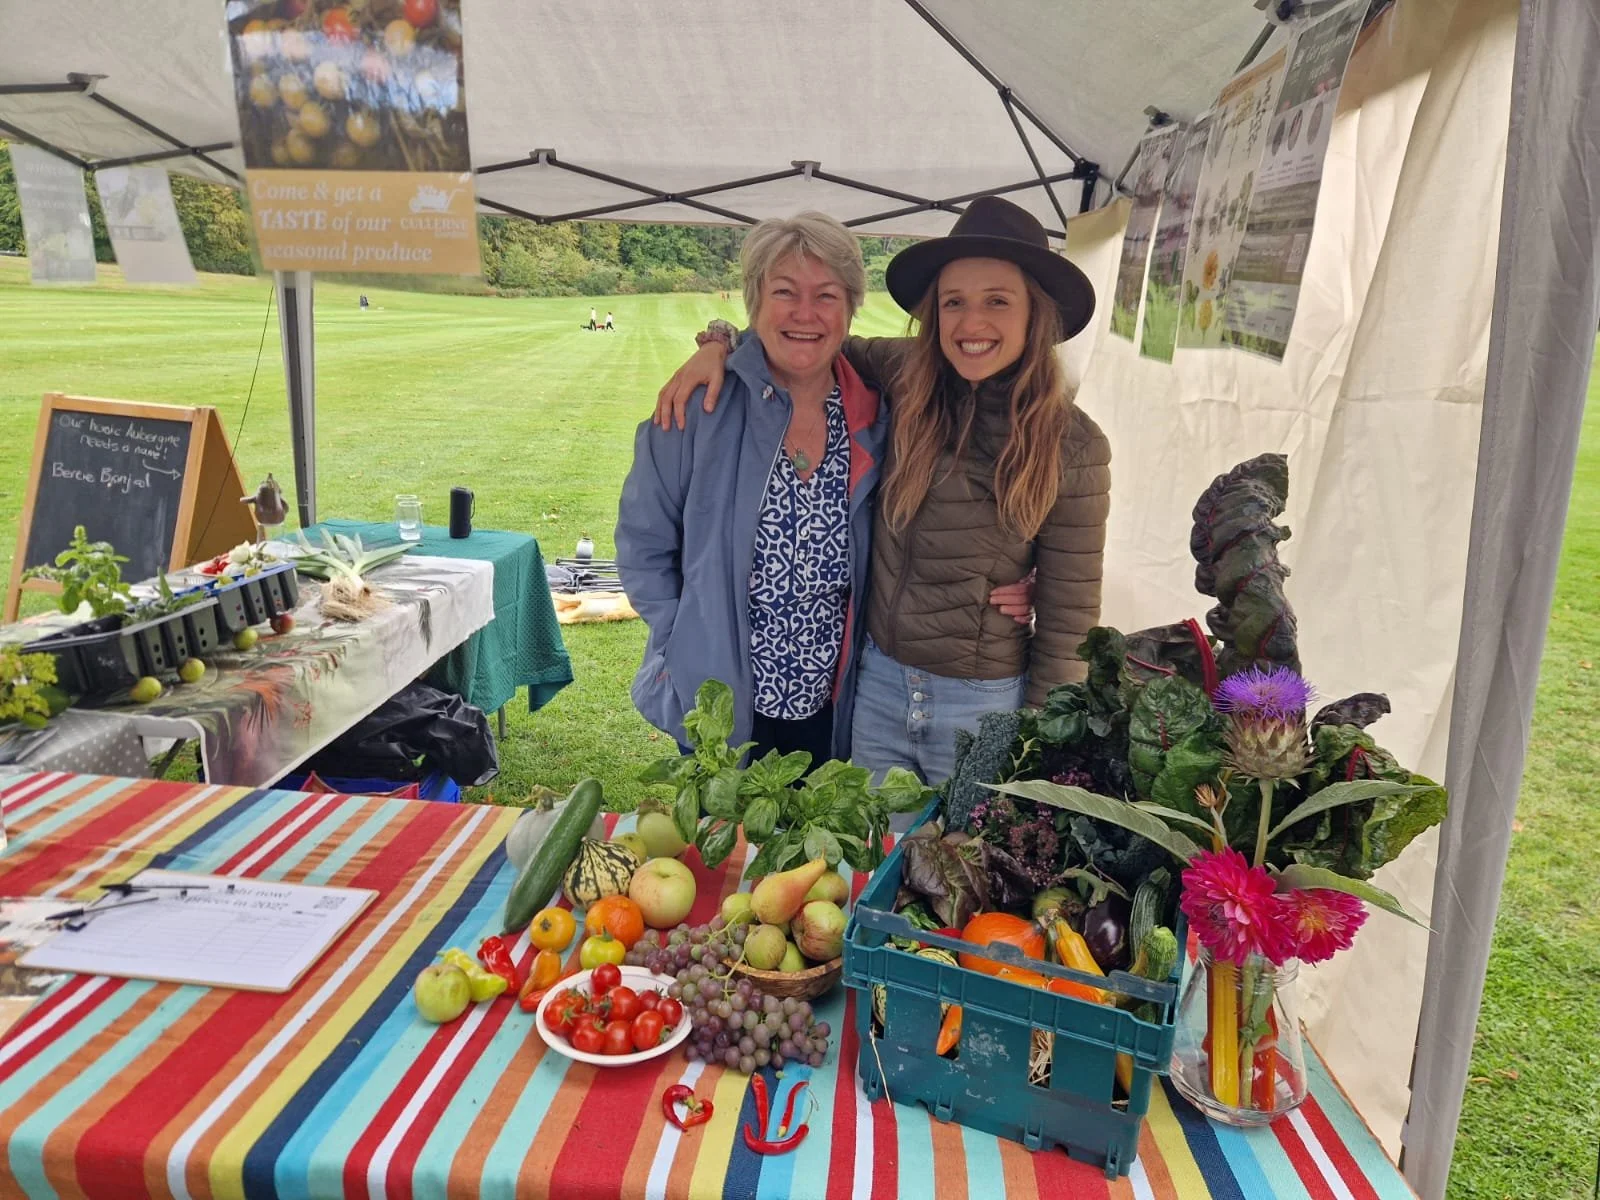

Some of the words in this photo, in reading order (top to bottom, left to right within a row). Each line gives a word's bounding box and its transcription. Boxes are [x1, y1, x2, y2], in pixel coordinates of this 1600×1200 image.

[252, 180, 308, 201] Come
[312, 180, 329, 201] &
[333, 184, 364, 208] get
[368, 184, 382, 201] a
[258, 209, 329, 231] TASTE
[332, 211, 353, 235] of
[355, 216, 392, 232] our
[262, 240, 348, 261] seasonal
[352, 241, 433, 266] produce
[80, 434, 119, 452] needs
